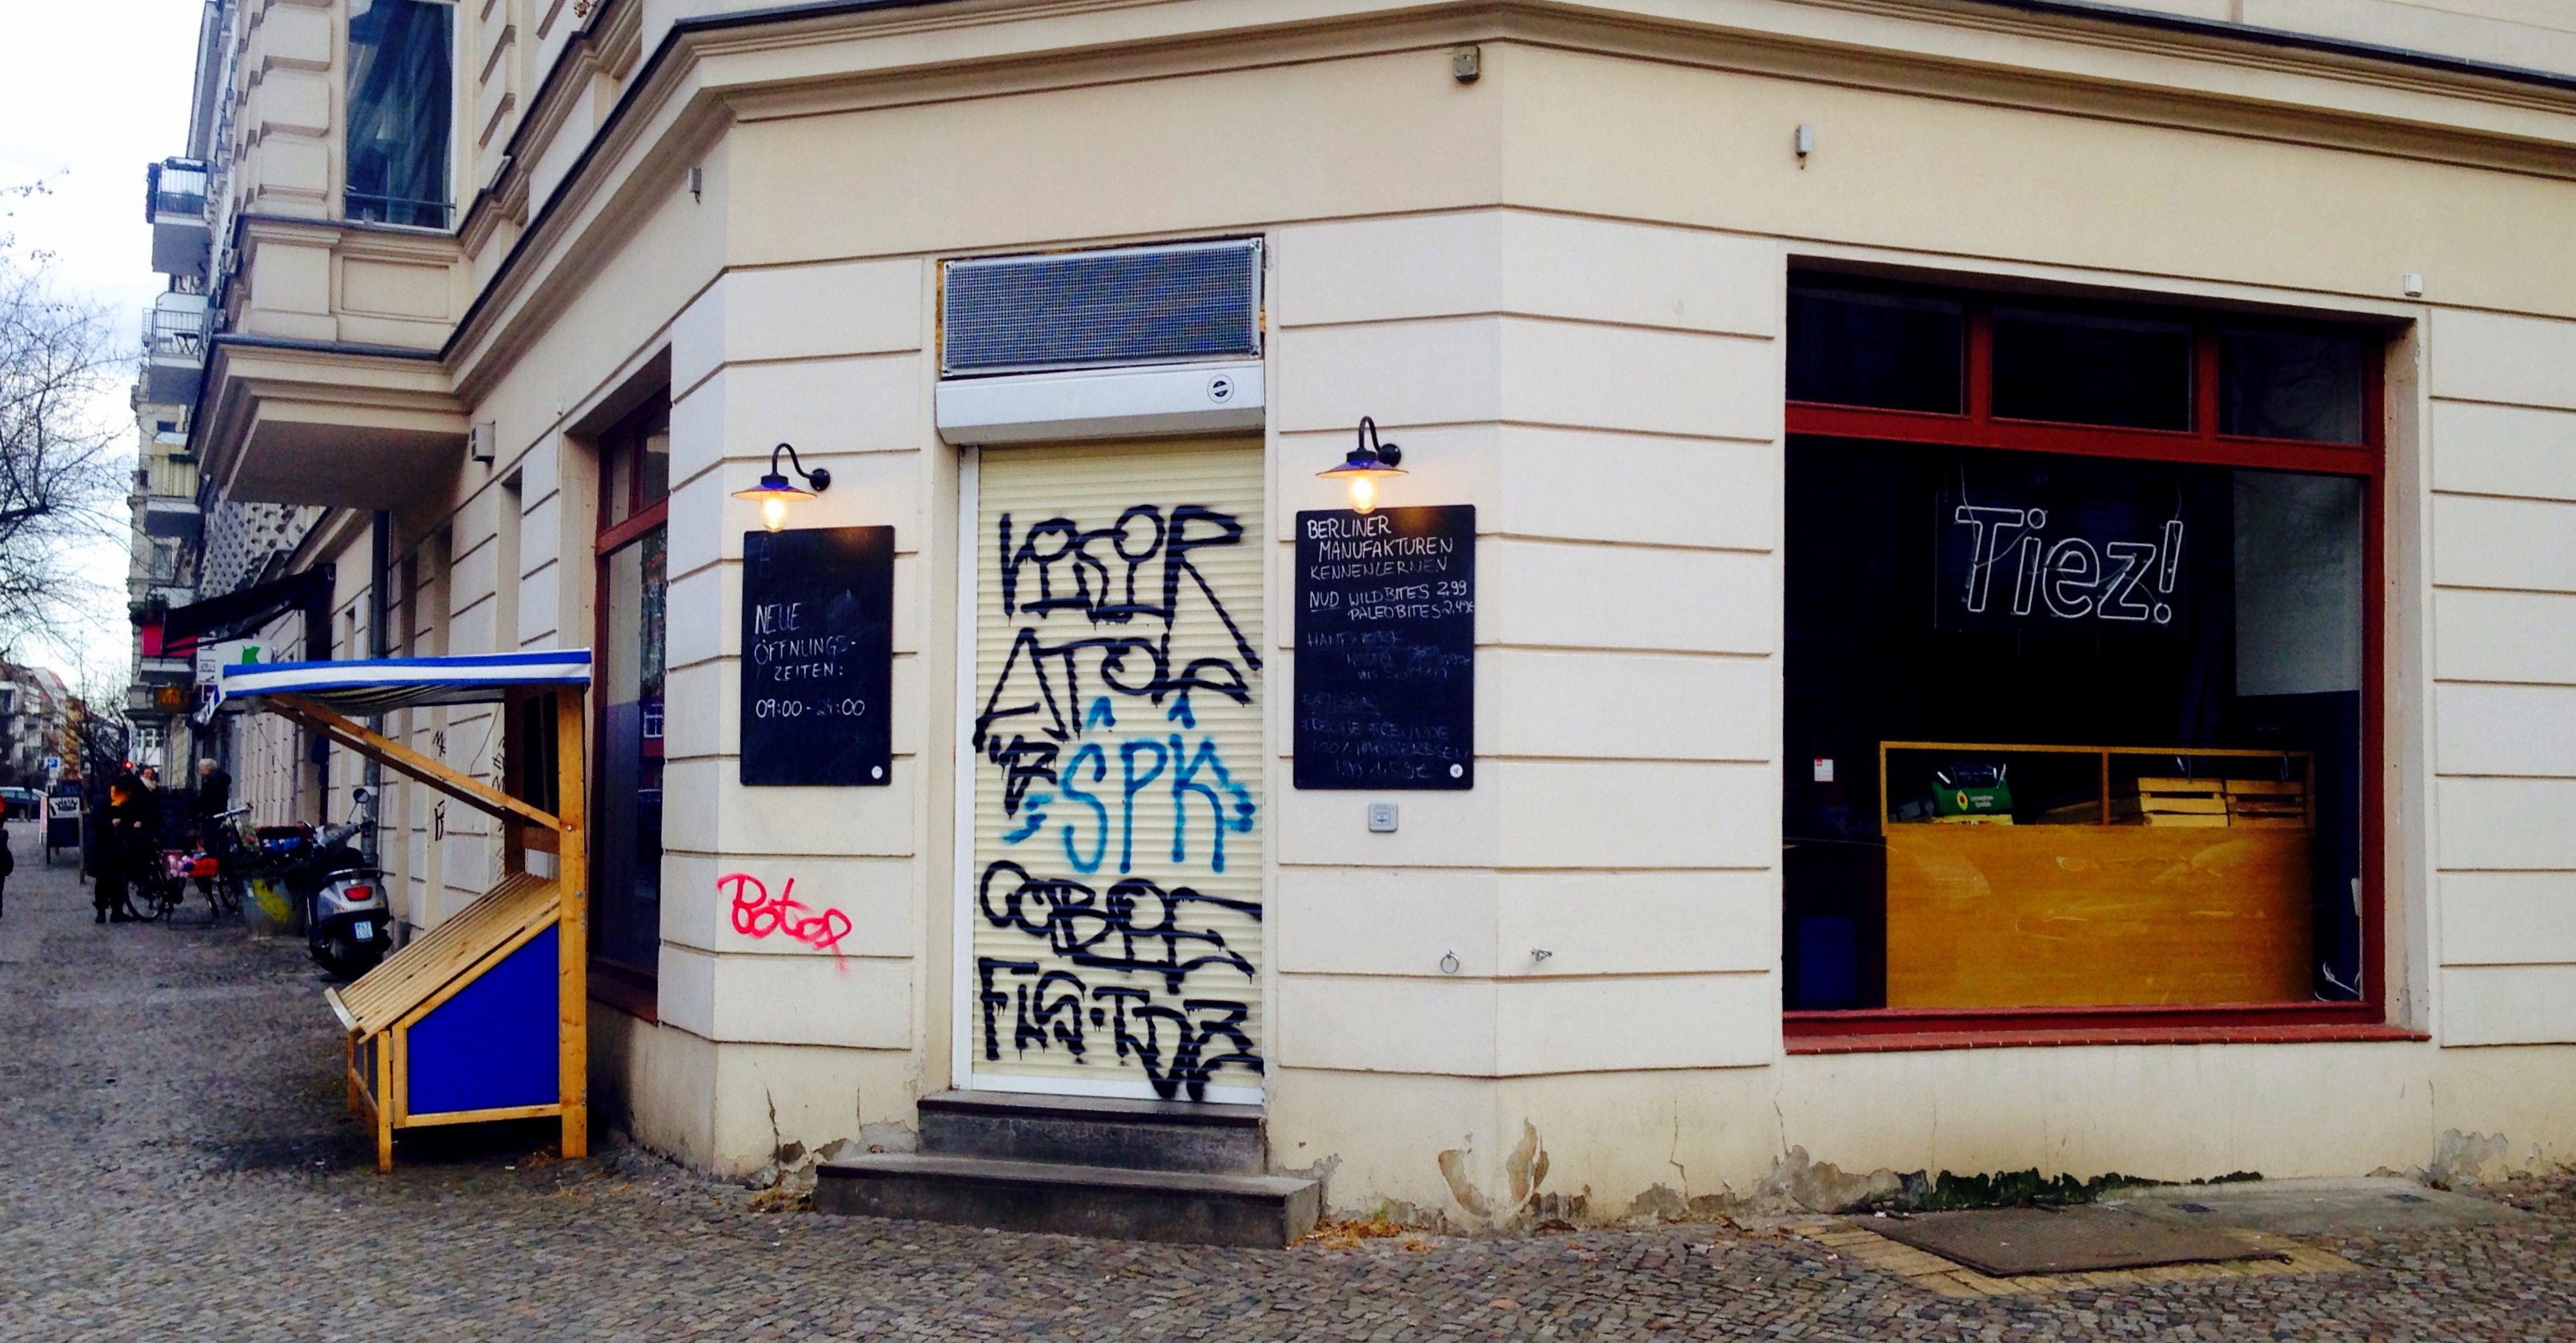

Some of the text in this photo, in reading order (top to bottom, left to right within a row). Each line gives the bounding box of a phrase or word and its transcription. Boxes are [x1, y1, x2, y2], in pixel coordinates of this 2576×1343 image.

[1307, 515, 1392, 539] BERLINER
[1319, 537, 1453, 563] MANUFAKTUREN
[1311, 556, 1448, 580] KENNENLERNEN
[1955, 505, 2183, 623] Tiez!
[1309, 591, 1340, 612] NUD
[1436, 579, 1467, 596] 2,99
[755, 603, 803, 635] NEUE
[1347, 603, 1441, 620] PALEOBITES
[774, 663, 843, 681] ZEITEN:
[755, 699, 803, 718] 09:00
